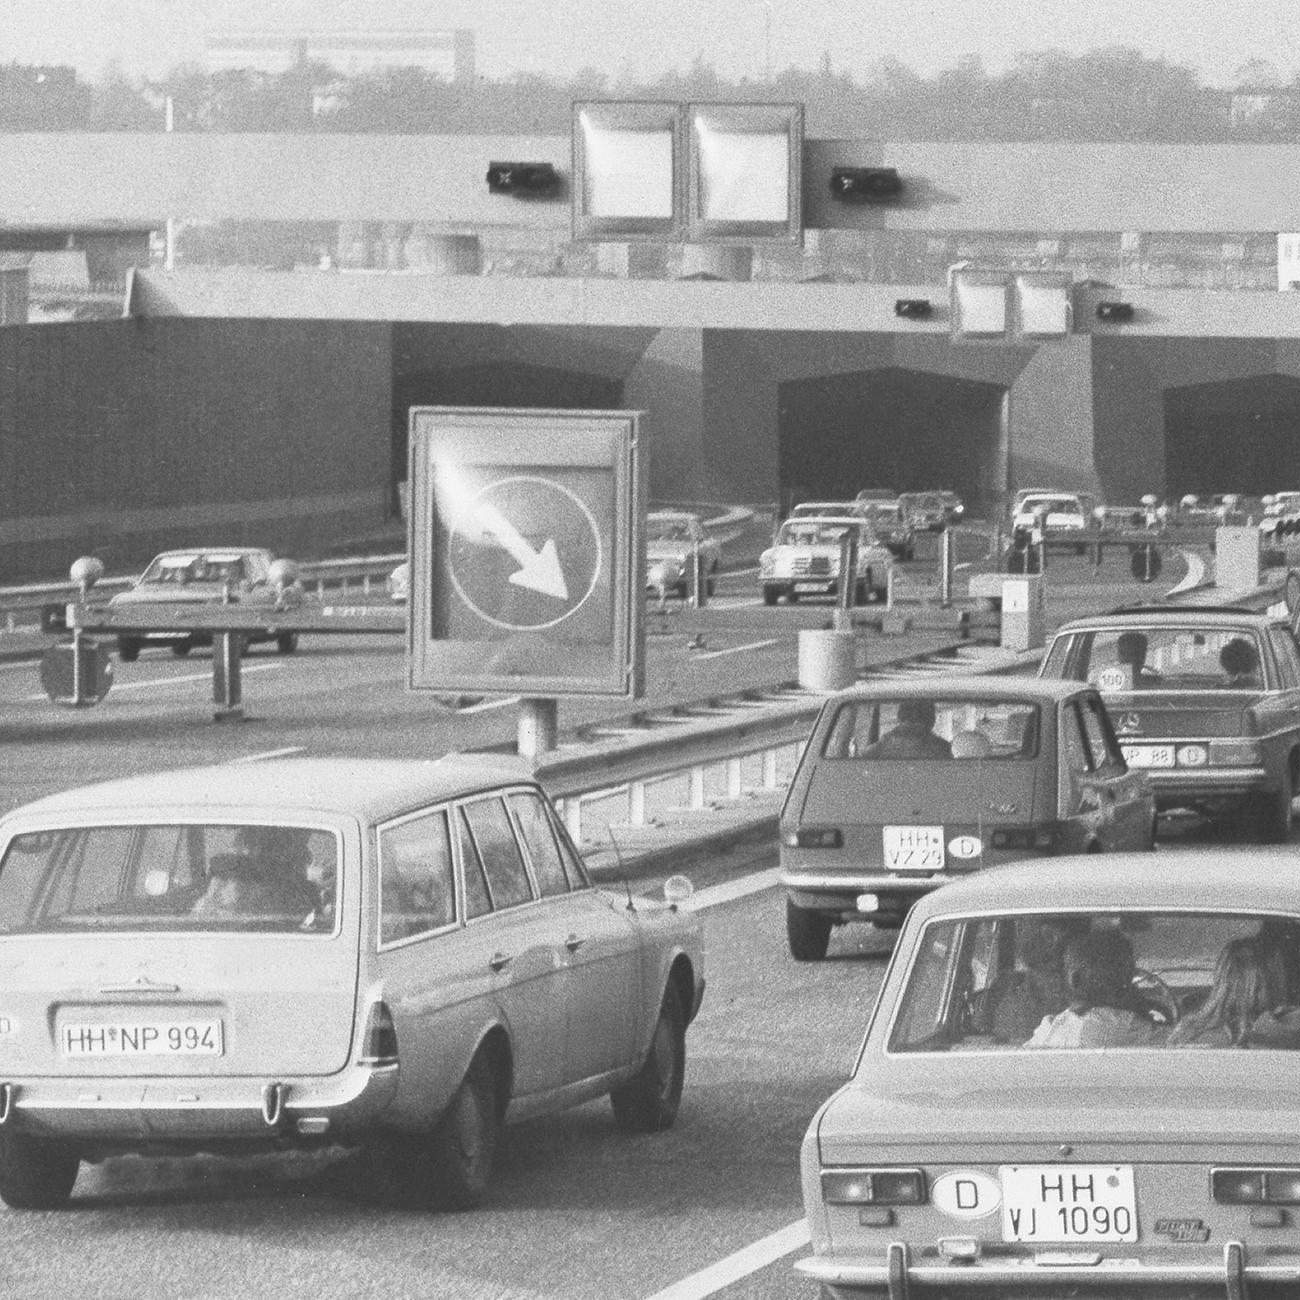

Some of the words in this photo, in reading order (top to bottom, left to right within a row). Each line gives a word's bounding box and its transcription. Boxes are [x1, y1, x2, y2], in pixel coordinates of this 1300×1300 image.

[1187, 748, 1199, 762] D
[900, 831, 929, 847] HH
[961, 839, 975, 855] D
[889, 850, 914, 865] VZ
[120, 1027, 160, 1051] NP
[167, 1025, 215, 1051] 994
[955, 1179, 979, 1210] D
[1040, 1173, 1095, 1203] HH
[1009, 1207, 1037, 1236] VJ
[1057, 1205, 1132, 1236] 1090
